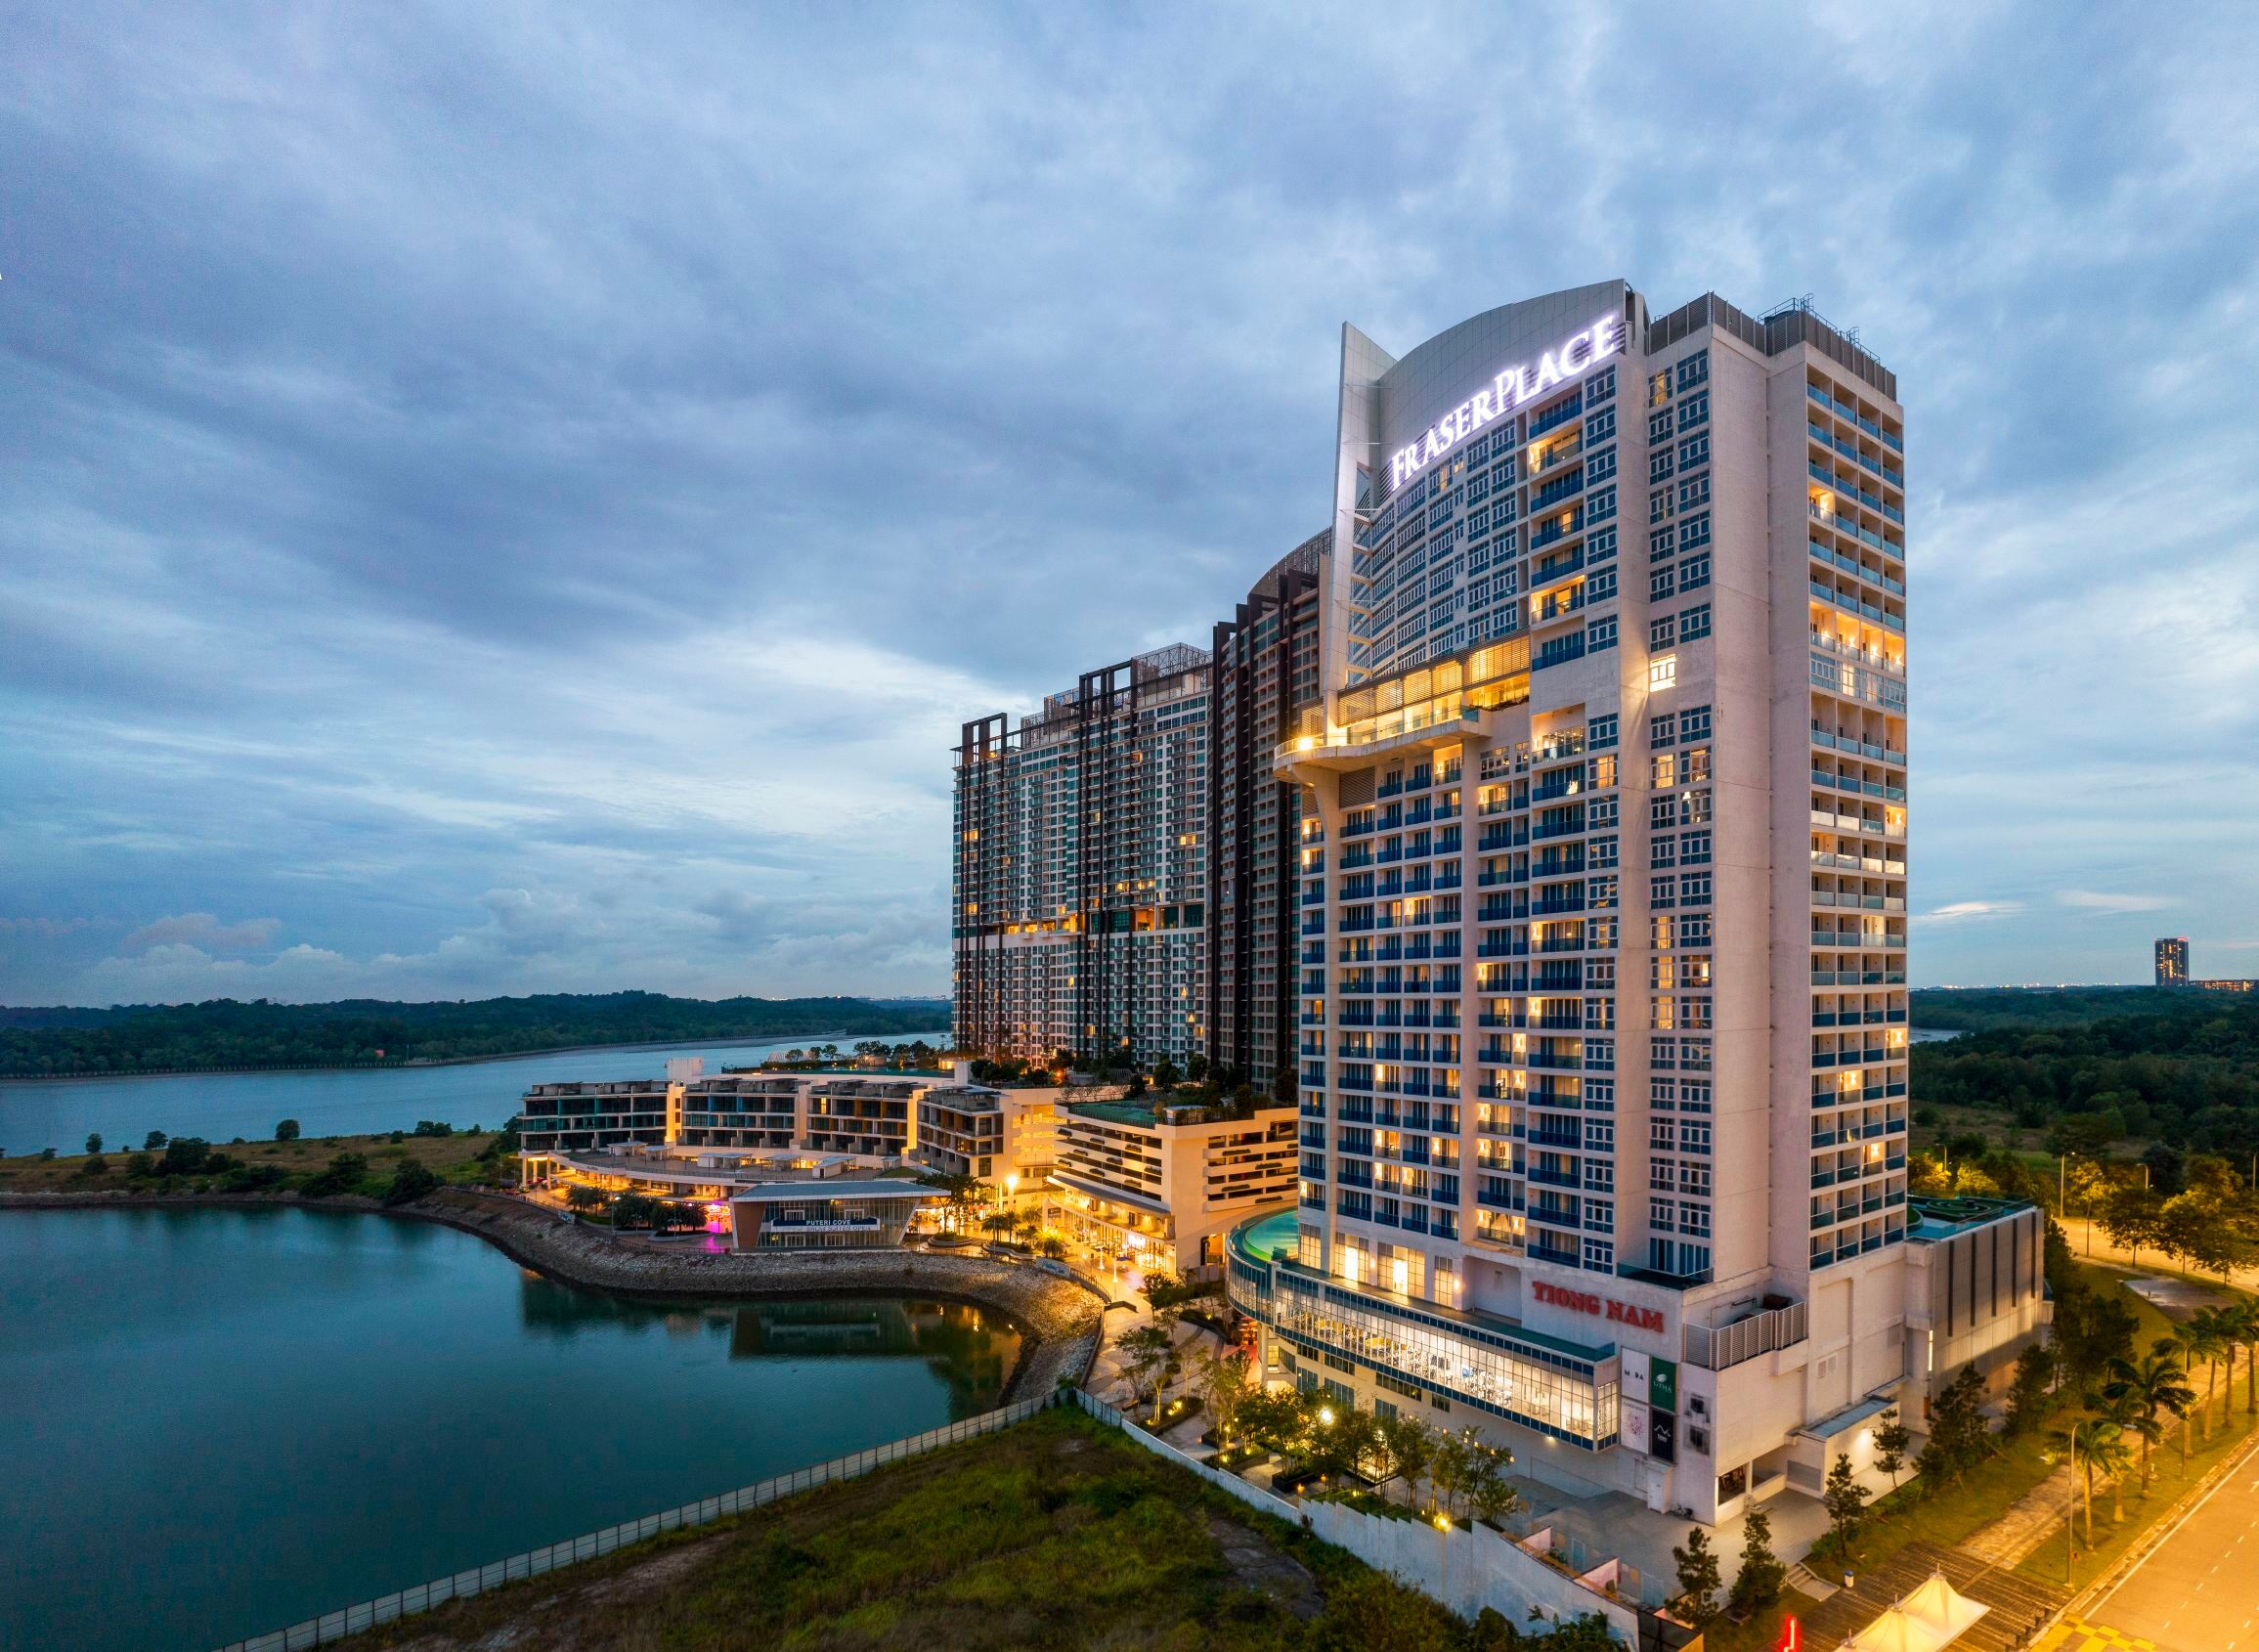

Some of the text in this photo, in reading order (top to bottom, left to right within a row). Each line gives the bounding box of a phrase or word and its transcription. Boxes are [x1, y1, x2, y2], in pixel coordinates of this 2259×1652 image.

[1391, 314, 1614, 492] FRASER PLACE
[1532, 1281, 1665, 1333] TIONG NAM
